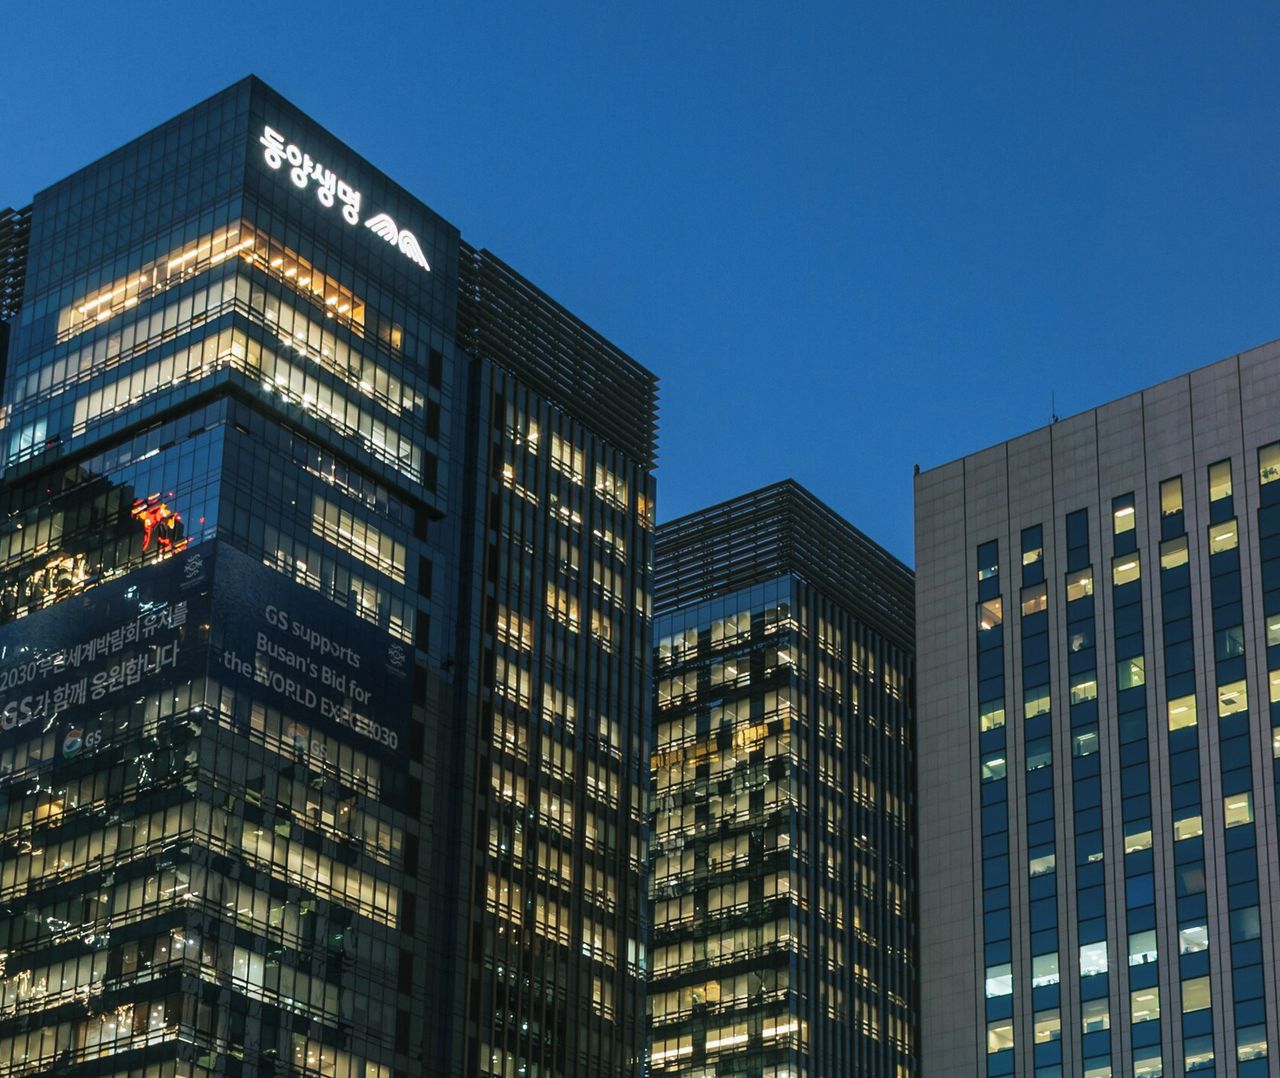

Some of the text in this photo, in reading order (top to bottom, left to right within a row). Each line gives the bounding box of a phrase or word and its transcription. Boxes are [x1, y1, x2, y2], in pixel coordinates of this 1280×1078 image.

[259, 125, 361, 226] 동양생명
[223, 650, 251, 677] the
[265, 604, 361, 668] GS supports
[1, 640, 180, 731] GS가 함께 응원합니다
[257, 632, 372, 705] Busan's Bid for
[86, 729, 102, 747] GS
[310, 739, 328, 758] GS
